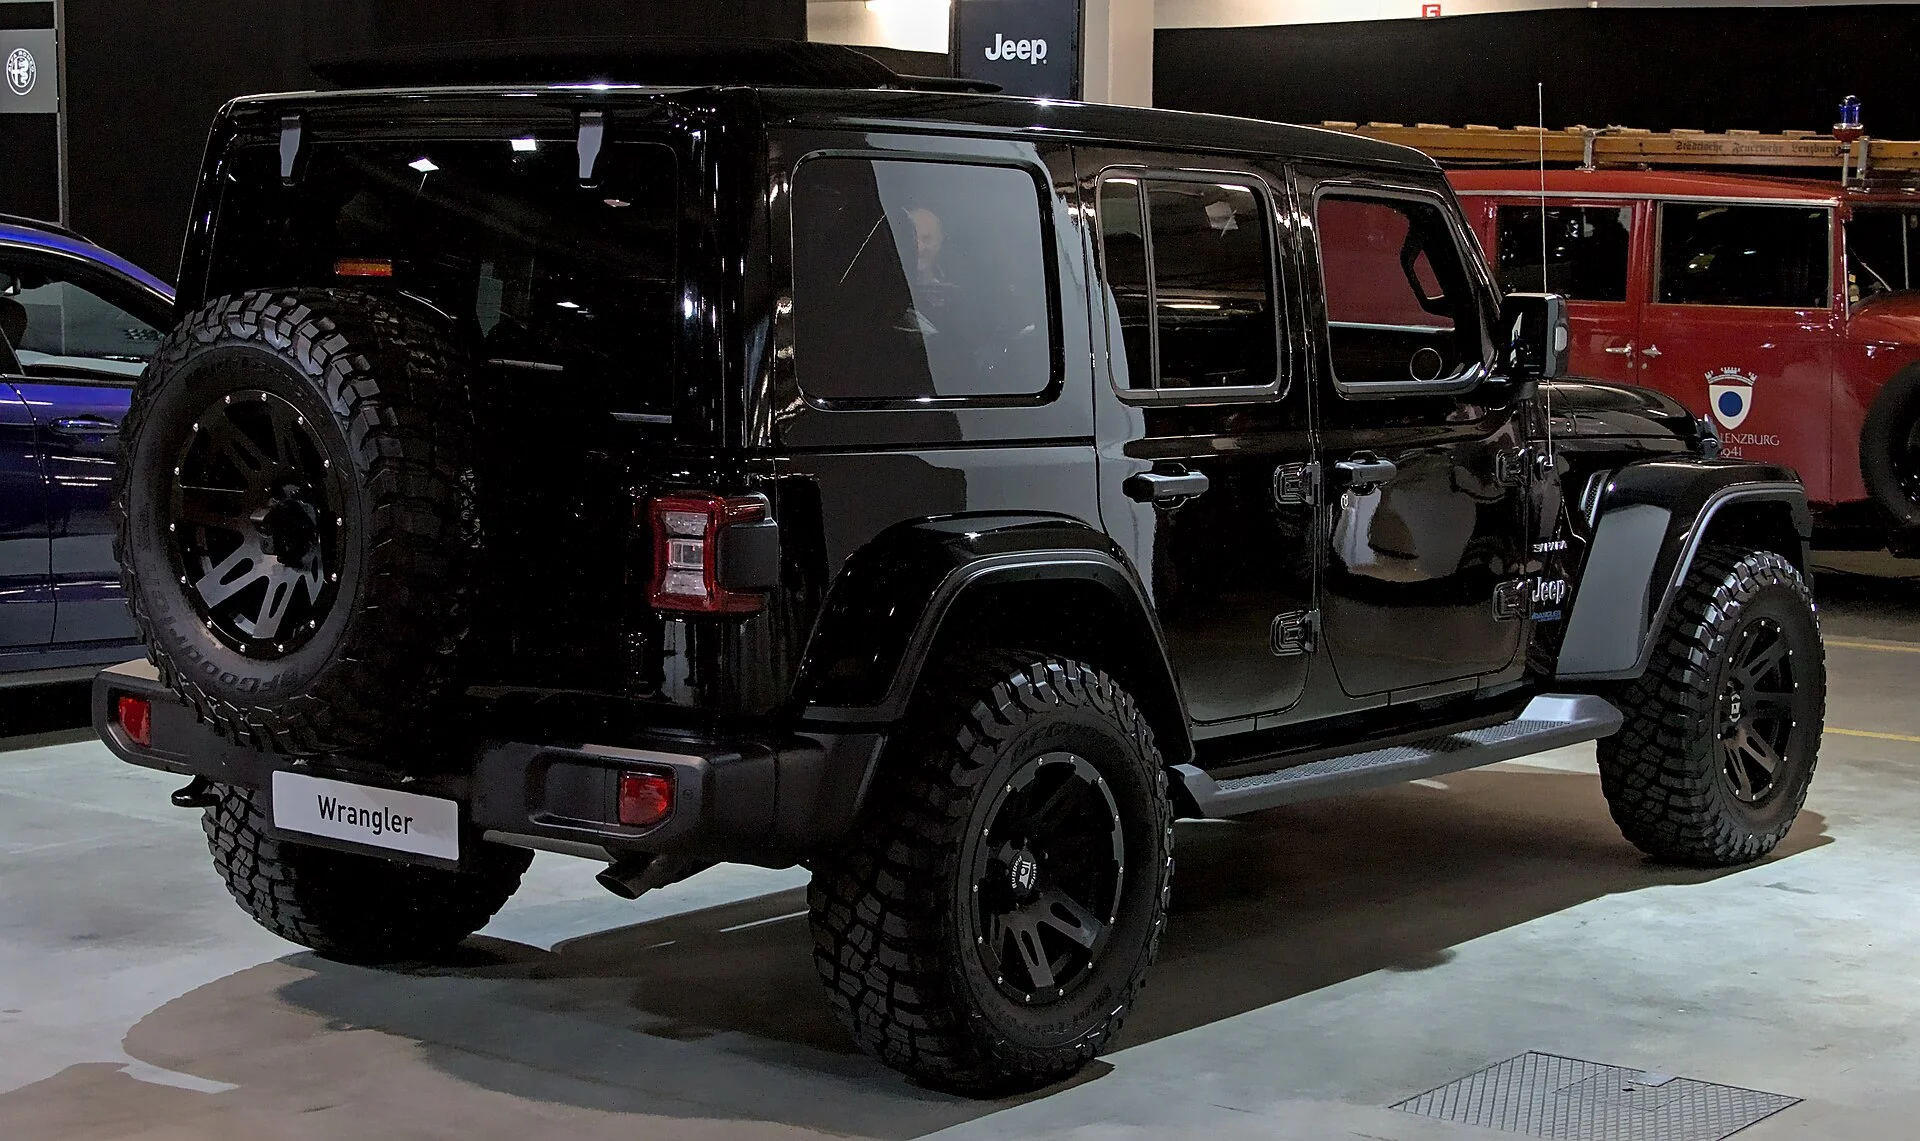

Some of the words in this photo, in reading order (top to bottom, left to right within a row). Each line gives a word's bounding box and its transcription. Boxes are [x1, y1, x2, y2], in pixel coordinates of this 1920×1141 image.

[985, 33, 1047, 65] Jeep
[1720, 432, 1780, 446] LENZBURG
[1532, 577, 1566, 605] Jeep
[317, 794, 414, 836] Wrangler
